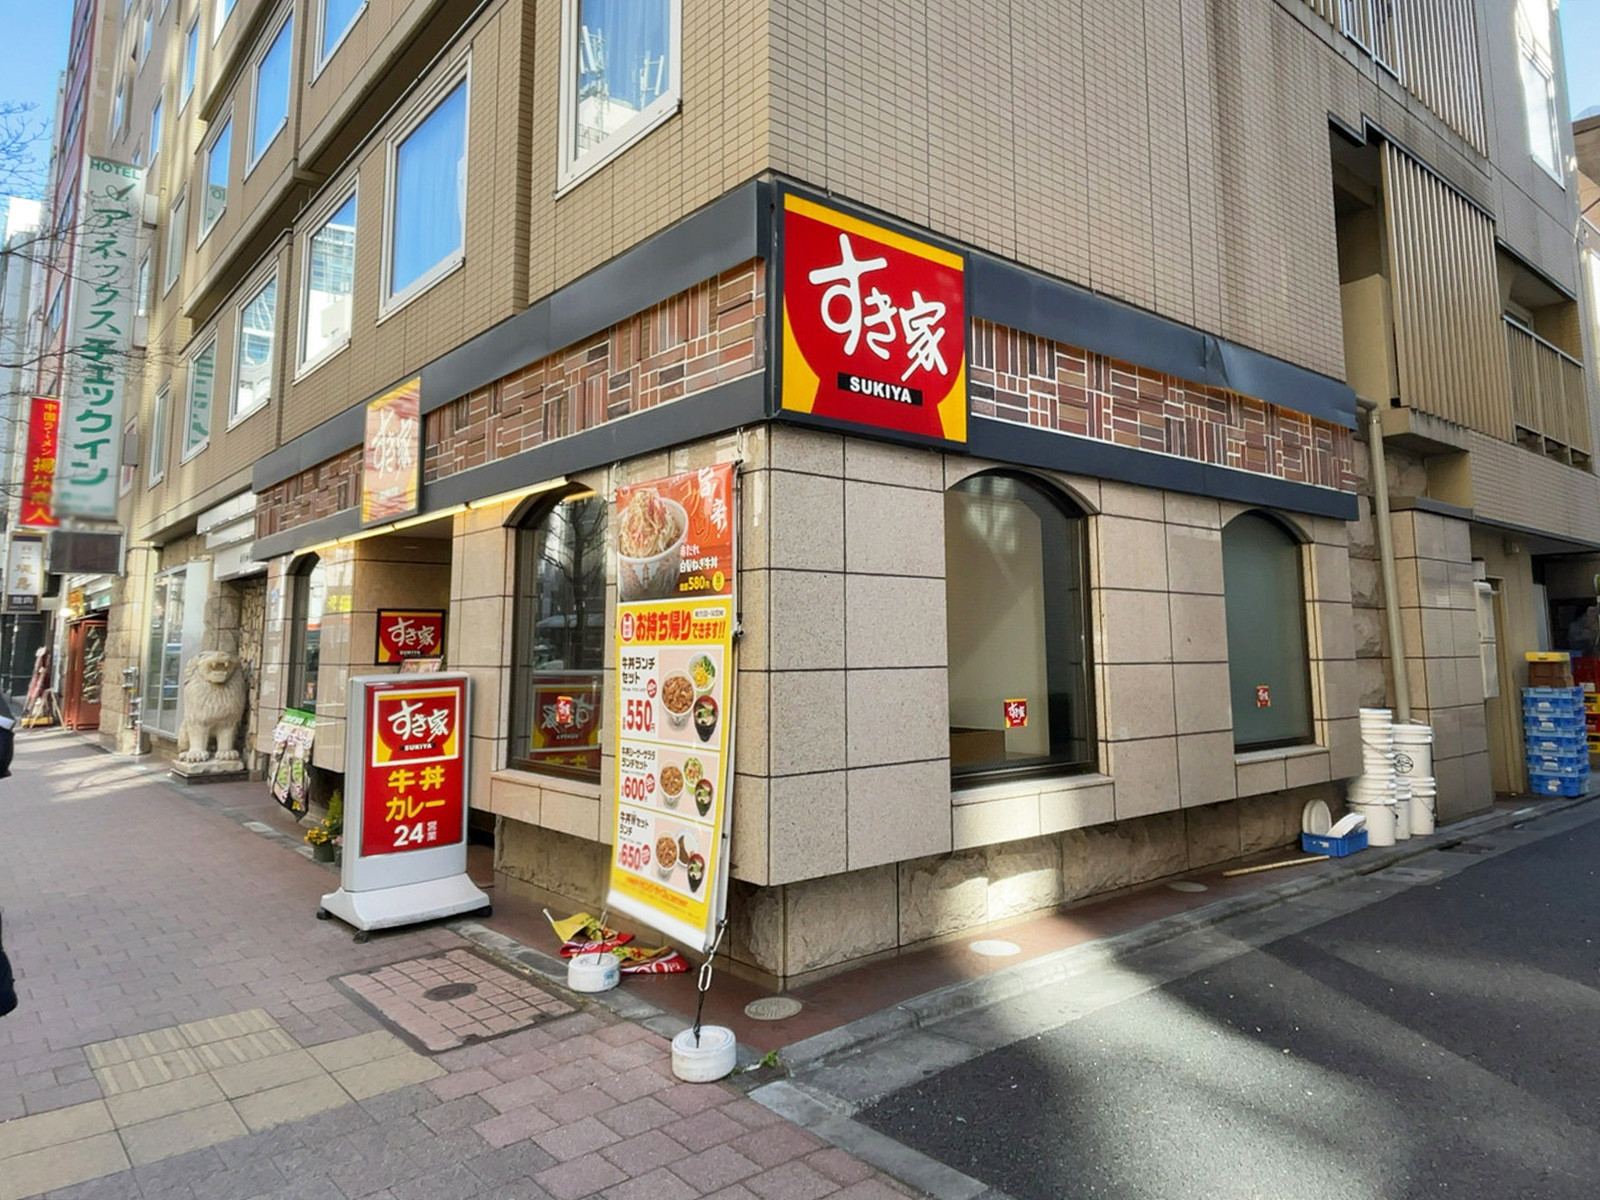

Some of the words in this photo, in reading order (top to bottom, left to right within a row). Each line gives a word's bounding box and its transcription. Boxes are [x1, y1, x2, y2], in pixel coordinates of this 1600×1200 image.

[89, 158, 141, 180] HOTEL
[808, 232, 948, 383] すき家
[849, 375, 912, 404] SUKIYA
[387, 616, 435, 650] すき家
[621, 656, 656, 671] 牛丼ランチ
[621, 671, 641, 685] セット
[387, 699, 449, 743] すき家
[387, 764, 446, 794] 牛丼
[385, 795, 446, 823] カレー
